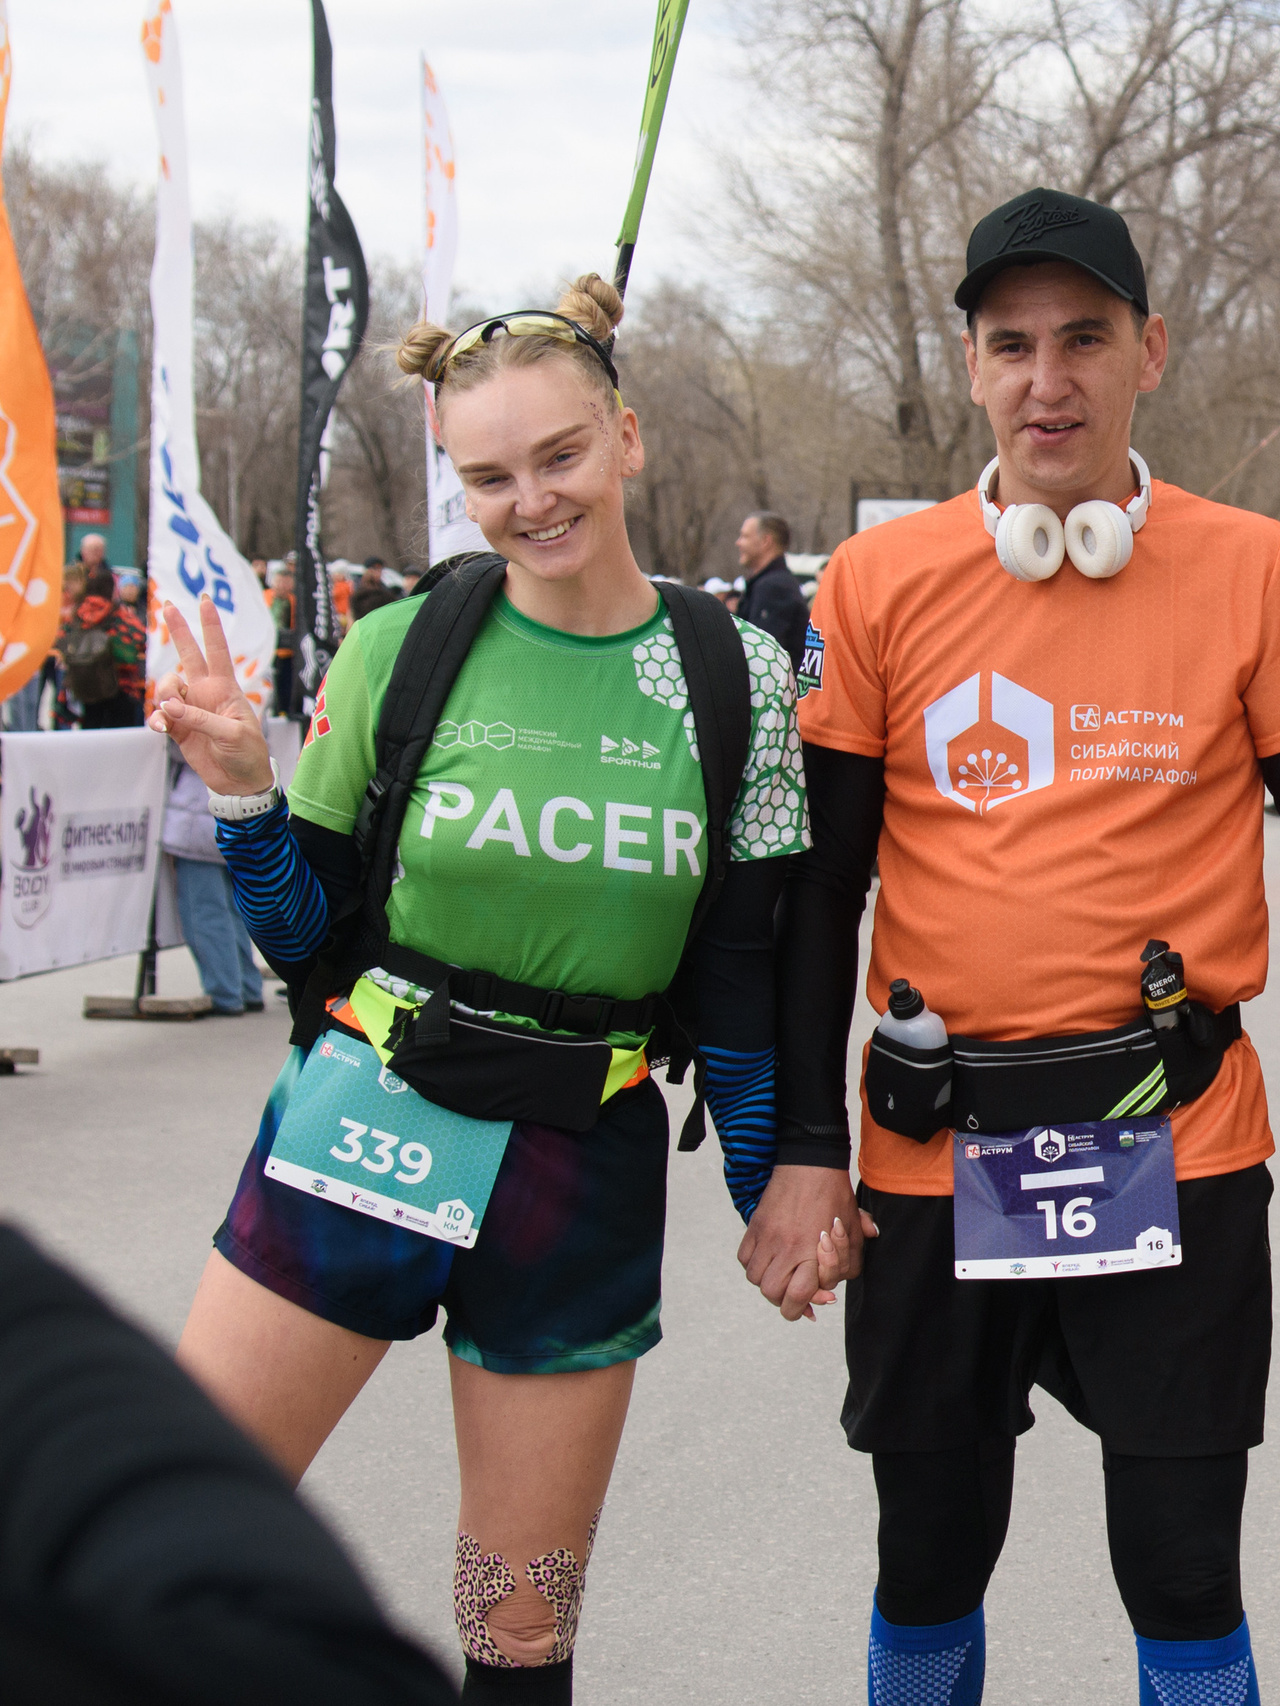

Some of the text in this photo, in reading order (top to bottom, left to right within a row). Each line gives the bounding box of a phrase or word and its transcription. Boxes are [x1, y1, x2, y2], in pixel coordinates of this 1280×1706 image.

[997, 201, 1088, 254] Protest
[1103, 709, 1184, 728] АСТРУМ
[518, 728, 557, 738] УФИМСКИЙ
[517, 743, 551, 752] МАРАФОН
[1070, 739, 1179, 760] СИБАЙСКИЙ
[600, 755, 661, 770] SPORTHUB
[1069, 765, 1198, 786] ПОЛУМАРАФОН
[419, 781, 702, 877] PACER
[1148, 973, 1176, 991] ENERGY
[1150, 988, 1166, 997] GEL
[331, 1051, 361, 1068] АСТРУМ
[329, 1116, 433, 1185] 339
[981, 1147, 1013, 1155] АСТРУМ
[446, 1204, 465, 1221] 10
[1036, 1197, 1097, 1240] 16
[442, 1221, 459, 1232] КМ
[1147, 1240, 1164, 1251] 16
